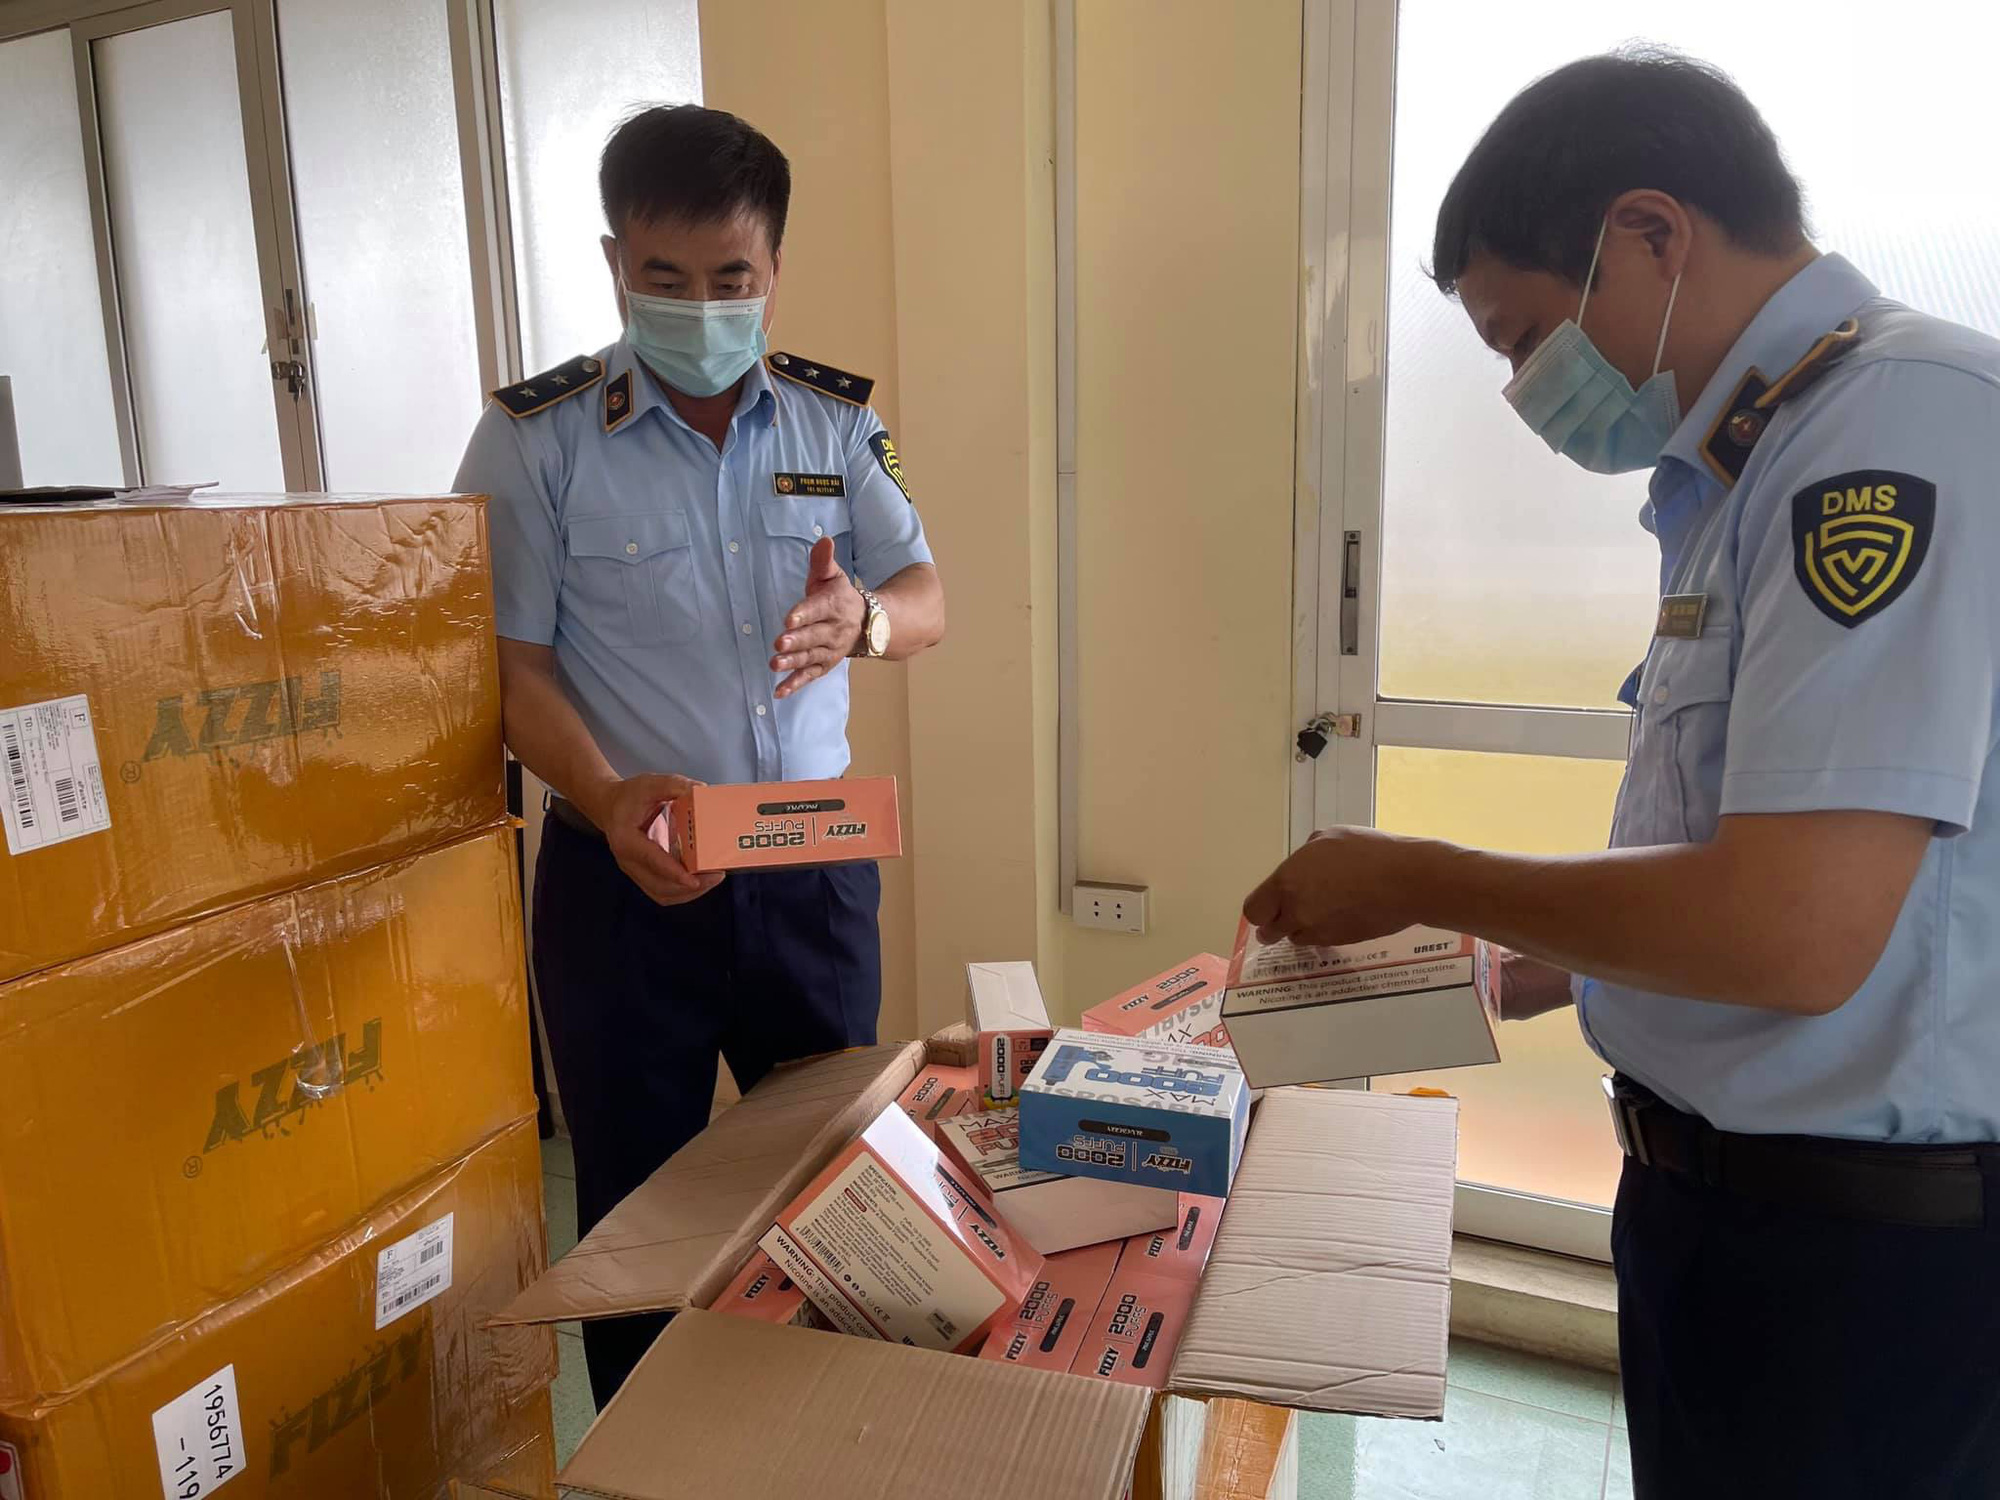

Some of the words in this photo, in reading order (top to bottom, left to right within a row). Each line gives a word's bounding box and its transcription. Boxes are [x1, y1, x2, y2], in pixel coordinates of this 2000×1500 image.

[1822, 484, 1898, 516] DMS
[755, 819, 805, 833] PUFFS
[823, 823, 867, 839] FIZZY
[738, 832, 805, 849] 2000
[1413, 941, 1450, 954] UREST
[1320, 975, 1361, 989] product
[1121, 994, 1150, 1011] FIZZY
[1141, 1066, 1225, 1083] PUFF
[1145, 1088, 1216, 1106] MAX
[960, 1113, 1019, 1131] MAX
[1073, 1135, 1126, 1152] PUFFS
[1057, 1144, 1125, 1167] 2000
[1143, 1153, 1191, 1174] FIZZY
[969, 1223, 1006, 1260] FIZZY
[1149, 1234, 1166, 1258] FIZZY
[744, 1273, 771, 1299] FIZZY
[774, 1235, 816, 1278] WARNING:
[813, 1276, 831, 1294] This
[826, 1291, 858, 1323] product
[783, 1258, 814, 1291] Nicotine
[811, 1288, 821, 1297] is
[818, 1296, 829, 1307] an
[1019, 1281, 1050, 1320] 2000
[1108, 1294, 1137, 1335] 2000
[1125, 1305, 1147, 1337] PUFFS
[1004, 1331, 1029, 1361] FIZZY
[1097, 1345, 1120, 1377] FIZZY
[204, 1384, 234, 1479] 1956774
